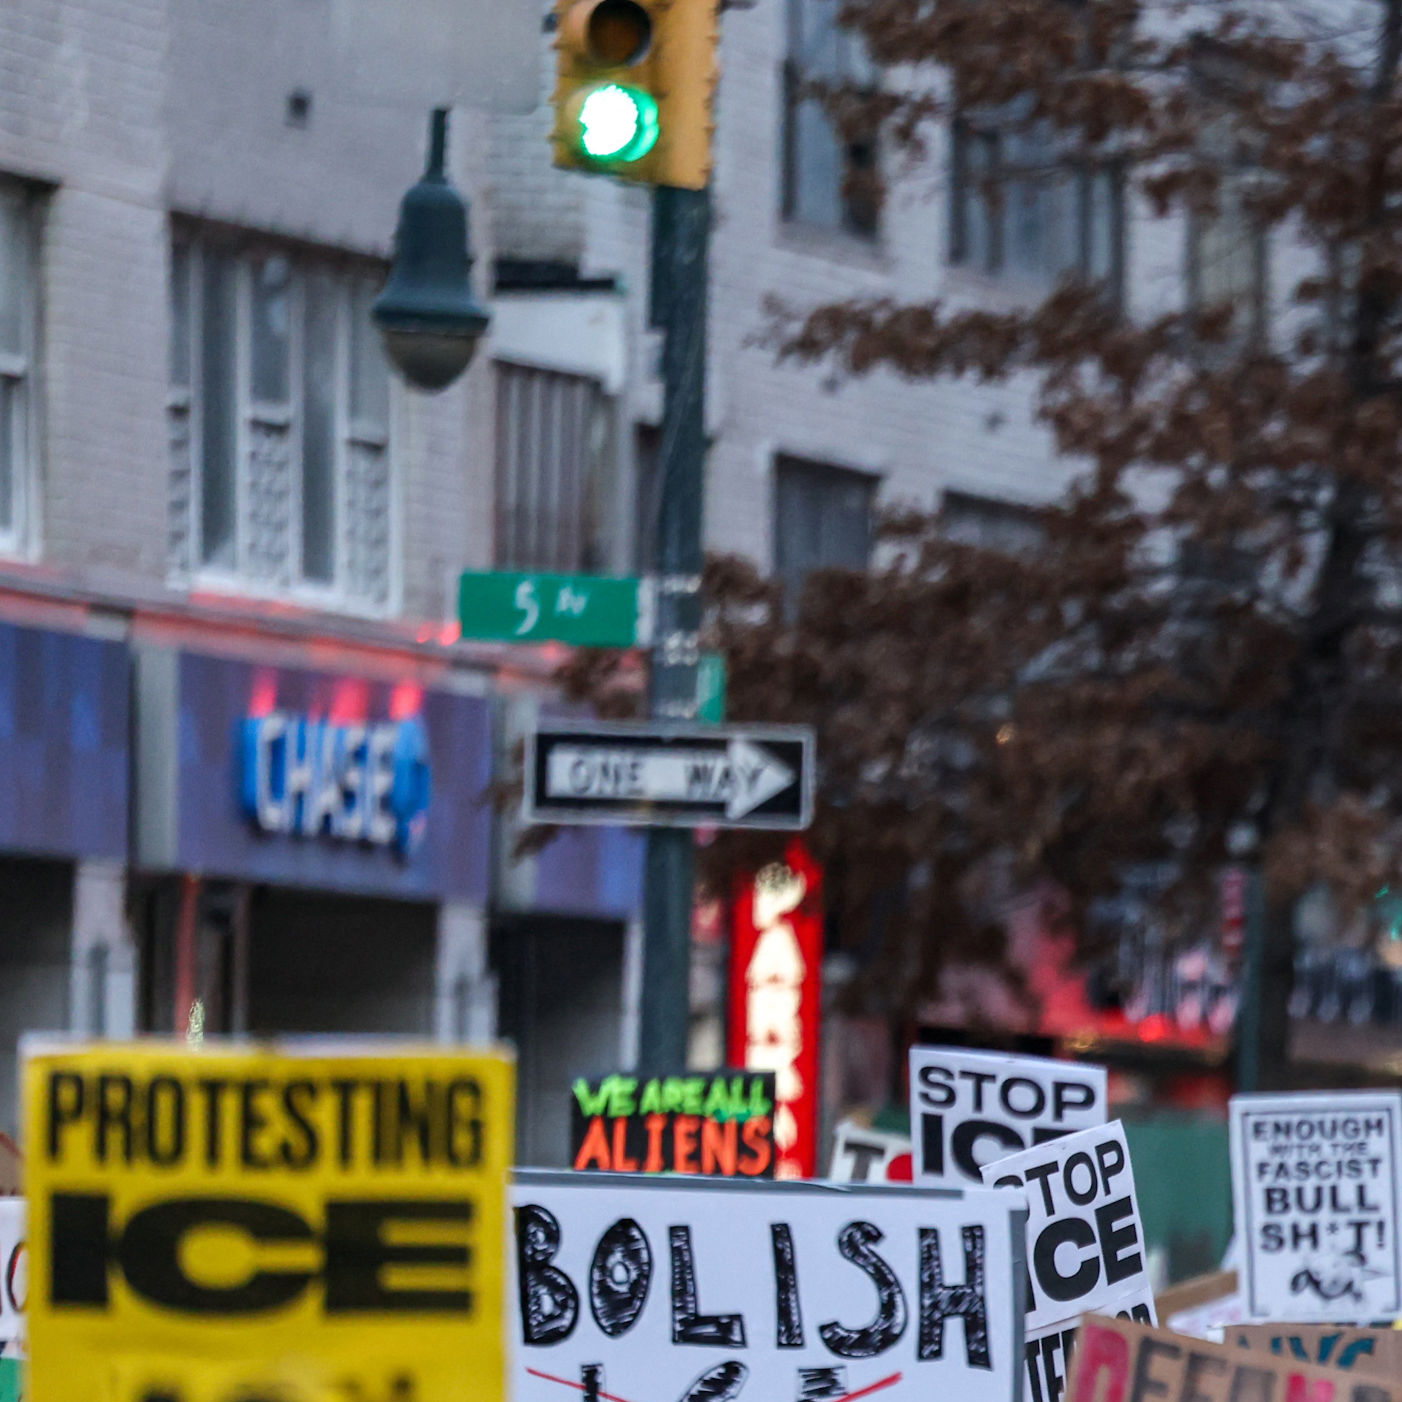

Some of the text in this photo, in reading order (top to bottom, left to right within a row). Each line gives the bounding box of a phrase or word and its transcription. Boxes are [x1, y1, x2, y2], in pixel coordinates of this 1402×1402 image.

[514, 579, 540, 635] 5
[569, 758, 766, 799] ONE WAY
[46, 1071, 485, 1170] PROTESTING
[572, 1075, 772, 1118] WE ARE ALL
[918, 1065, 1095, 1121] STOP
[573, 1114, 772, 1177] ALIENS
[921, 1113, 1080, 1185] IC
[1252, 1117, 1384, 1140] ENOUGH
[1329, 1142, 1368, 1155] THE
[1256, 1158, 1383, 1182] FASCIST
[1264, 1185, 1381, 1215] BULL
[49, 1192, 474, 1323] ICE
[1025, 1195, 1144, 1313] CE
[513, 1203, 993, 1371] BOLISH
